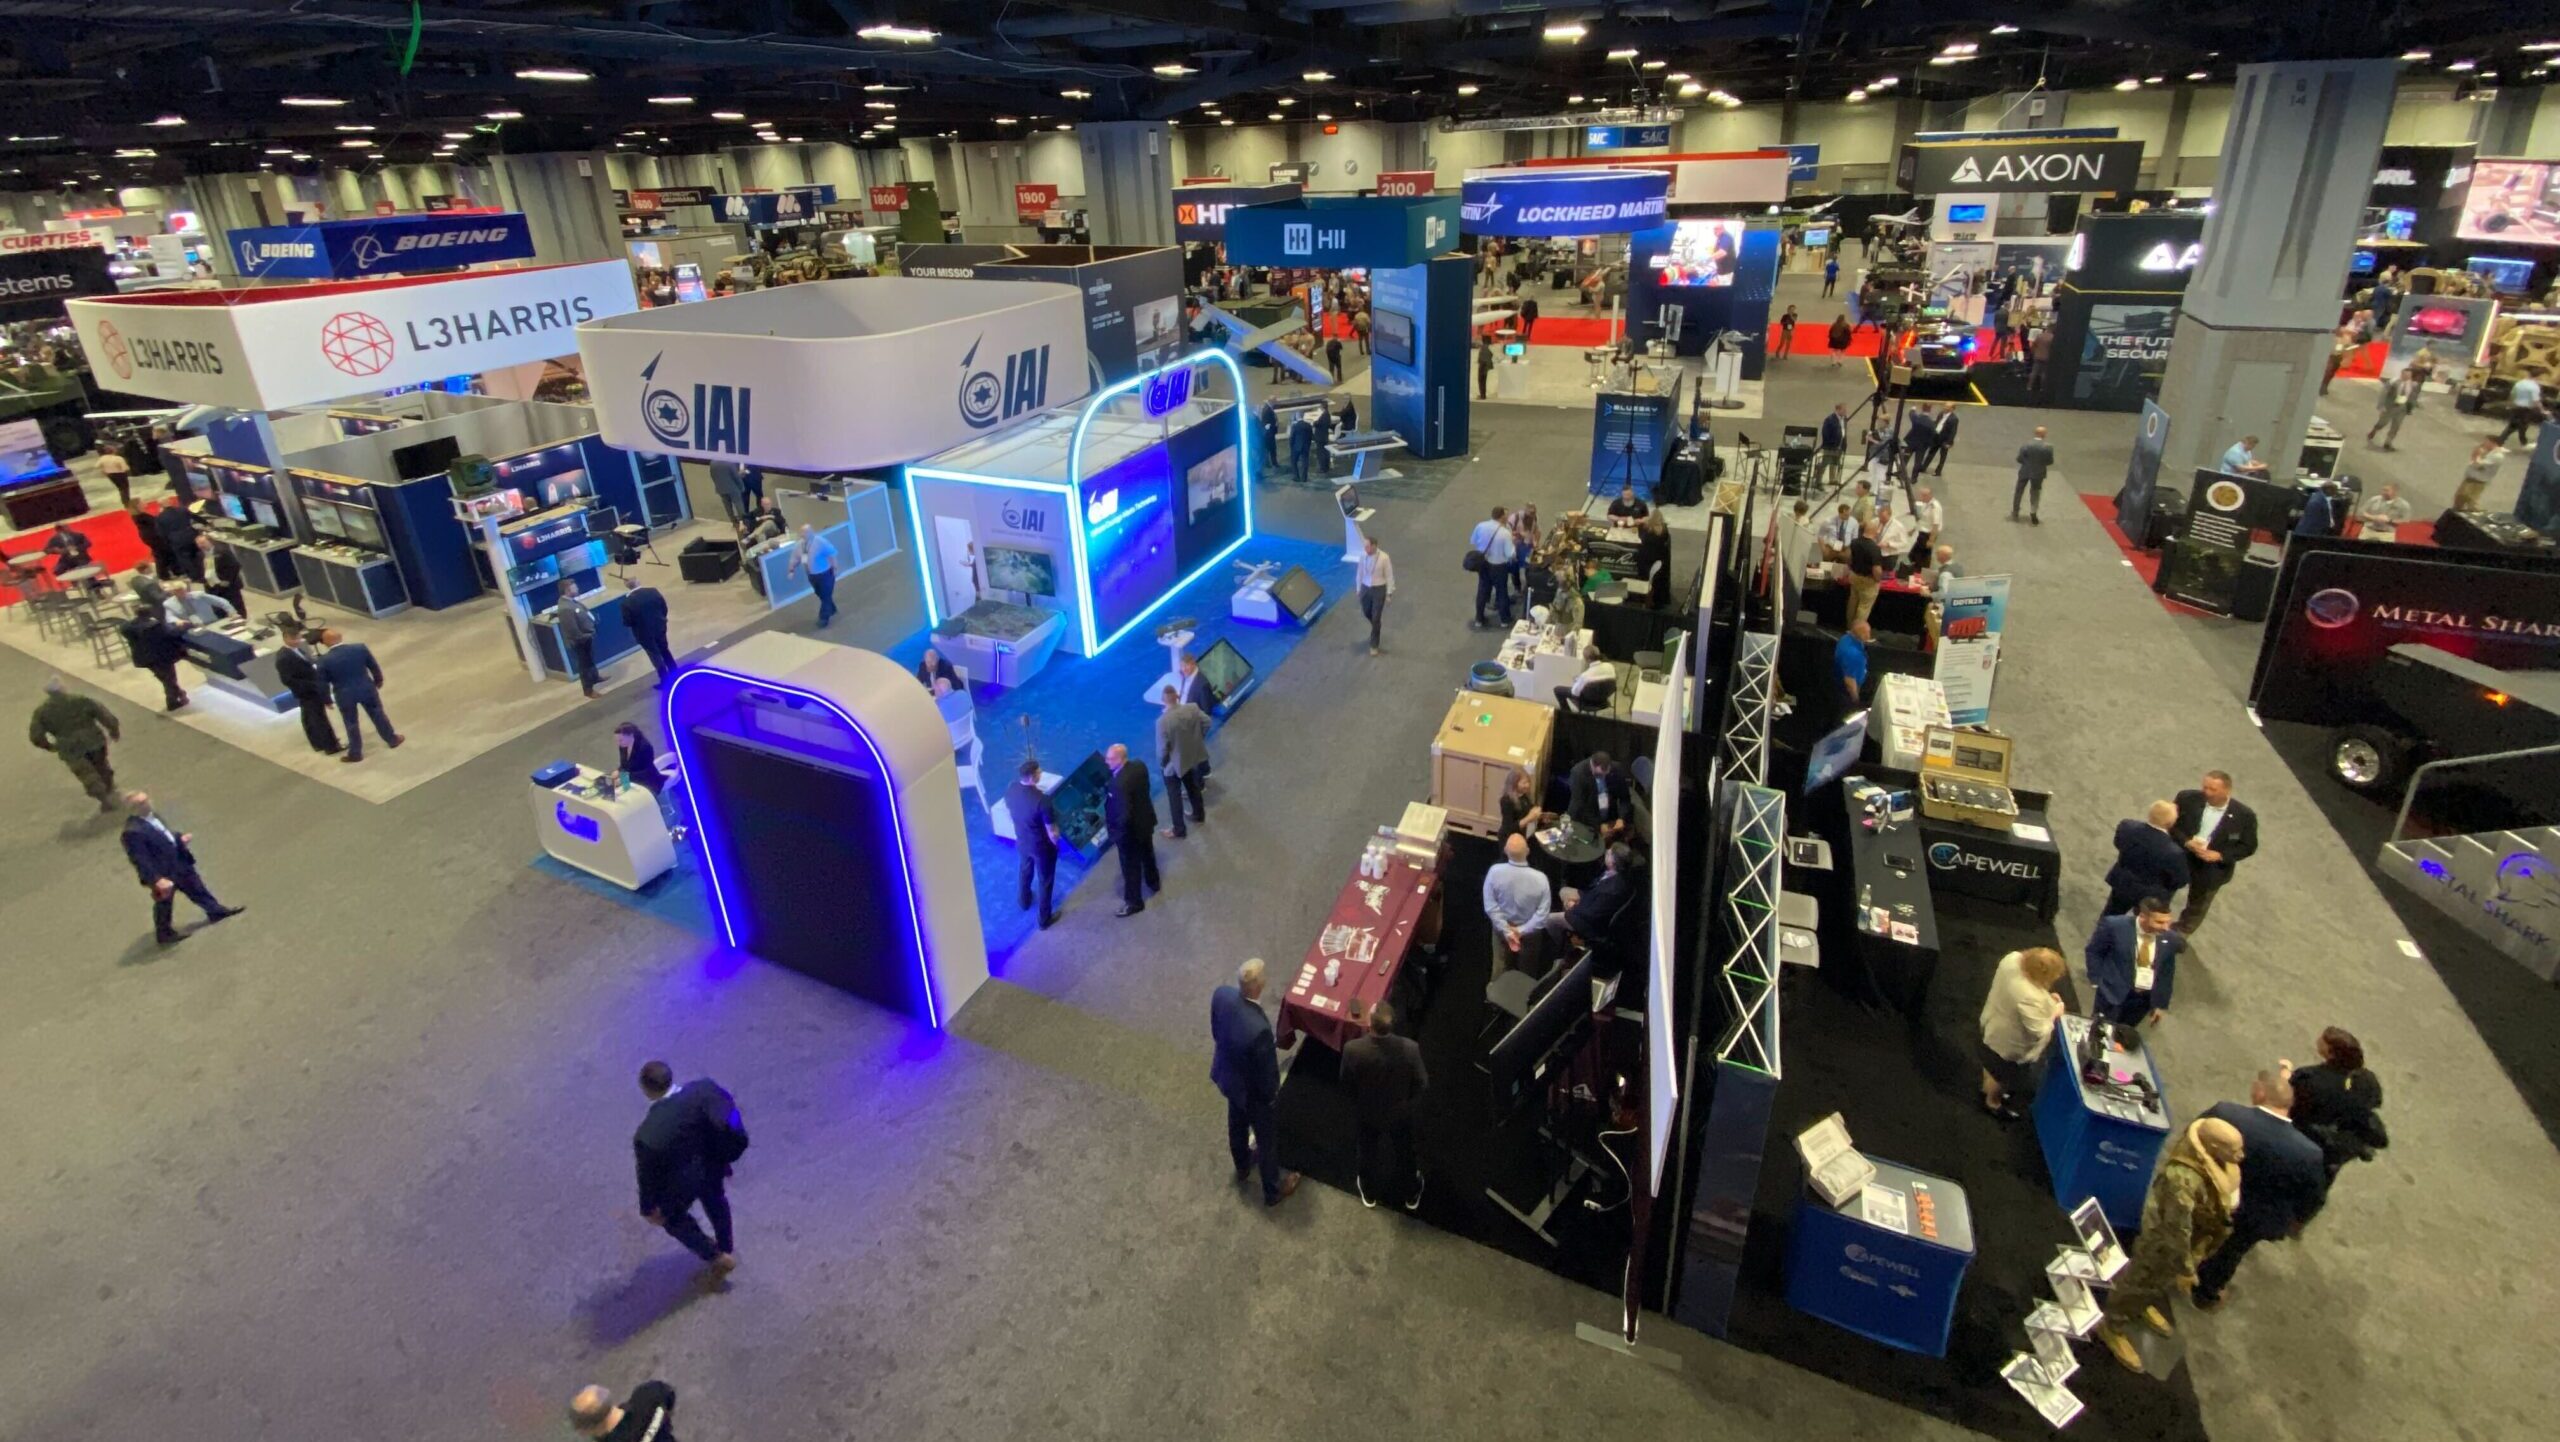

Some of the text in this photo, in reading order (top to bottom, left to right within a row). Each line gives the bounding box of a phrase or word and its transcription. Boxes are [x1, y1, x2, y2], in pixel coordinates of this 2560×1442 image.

[1985, 154, 2104, 182] AXON
[873, 194, 897, 205] 1800
[1019, 191, 1046, 204] 1900
[1381, 182, 1416, 196] 2100
[1516, 200, 1667, 223] LOCKHEED MARTIN
[260, 243, 315, 258] BOEING
[394, 227, 508, 251] BOEING
[1318, 229, 1345, 249] HII
[910, 267, 936, 277] YOUR
[407, 296, 595, 352] L3HARRIS
[2097, 335, 2174, 347] THE FUT
[130, 337, 223, 376] L3HARRIS
[2106, 348, 2169, 360] SECUR
[1002, 344, 1050, 421] IAI
[694, 383, 750, 456] IAI
[1022, 509, 1045, 532] IAI
[2372, 604, 2472, 629] METAL
[1928, 842, 2042, 879] CAPEWELL
